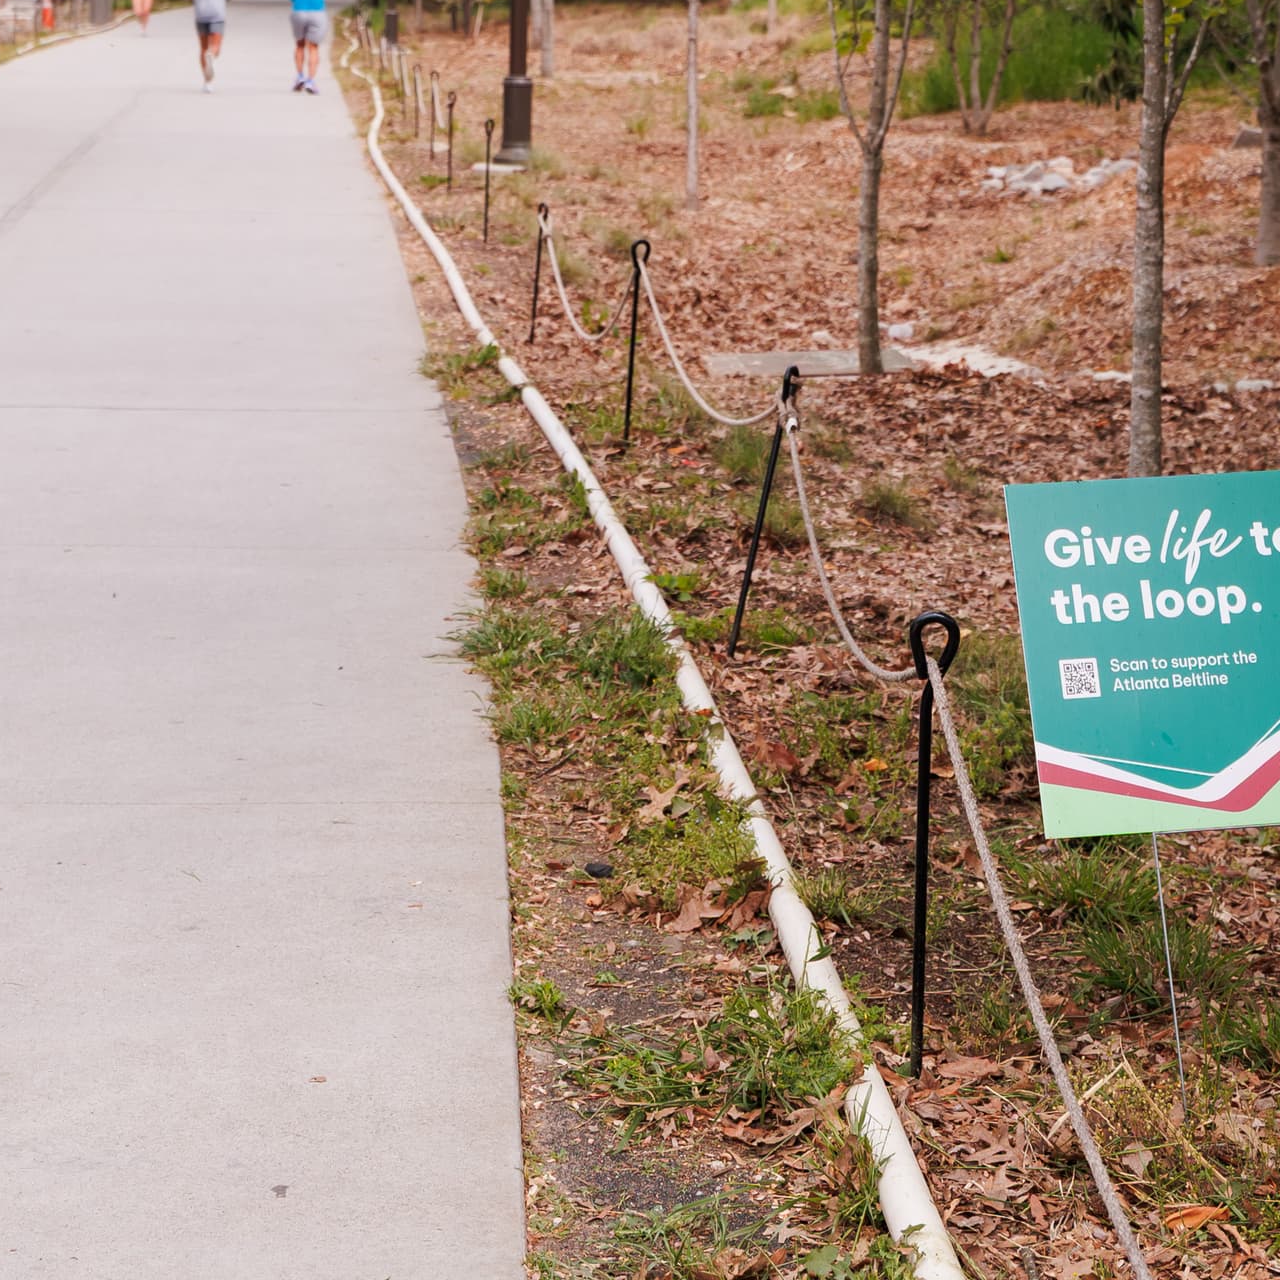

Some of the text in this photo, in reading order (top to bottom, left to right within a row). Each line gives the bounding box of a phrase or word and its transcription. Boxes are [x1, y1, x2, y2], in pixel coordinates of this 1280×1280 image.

[1044, 526, 1151, 568] Give
[1160, 508, 1243, 585] life
[1050, 580, 1263, 624] the loop.
[1110, 650, 1257, 673] Scan to support the
[1113, 672, 1228, 692] Atlanta Beltline
